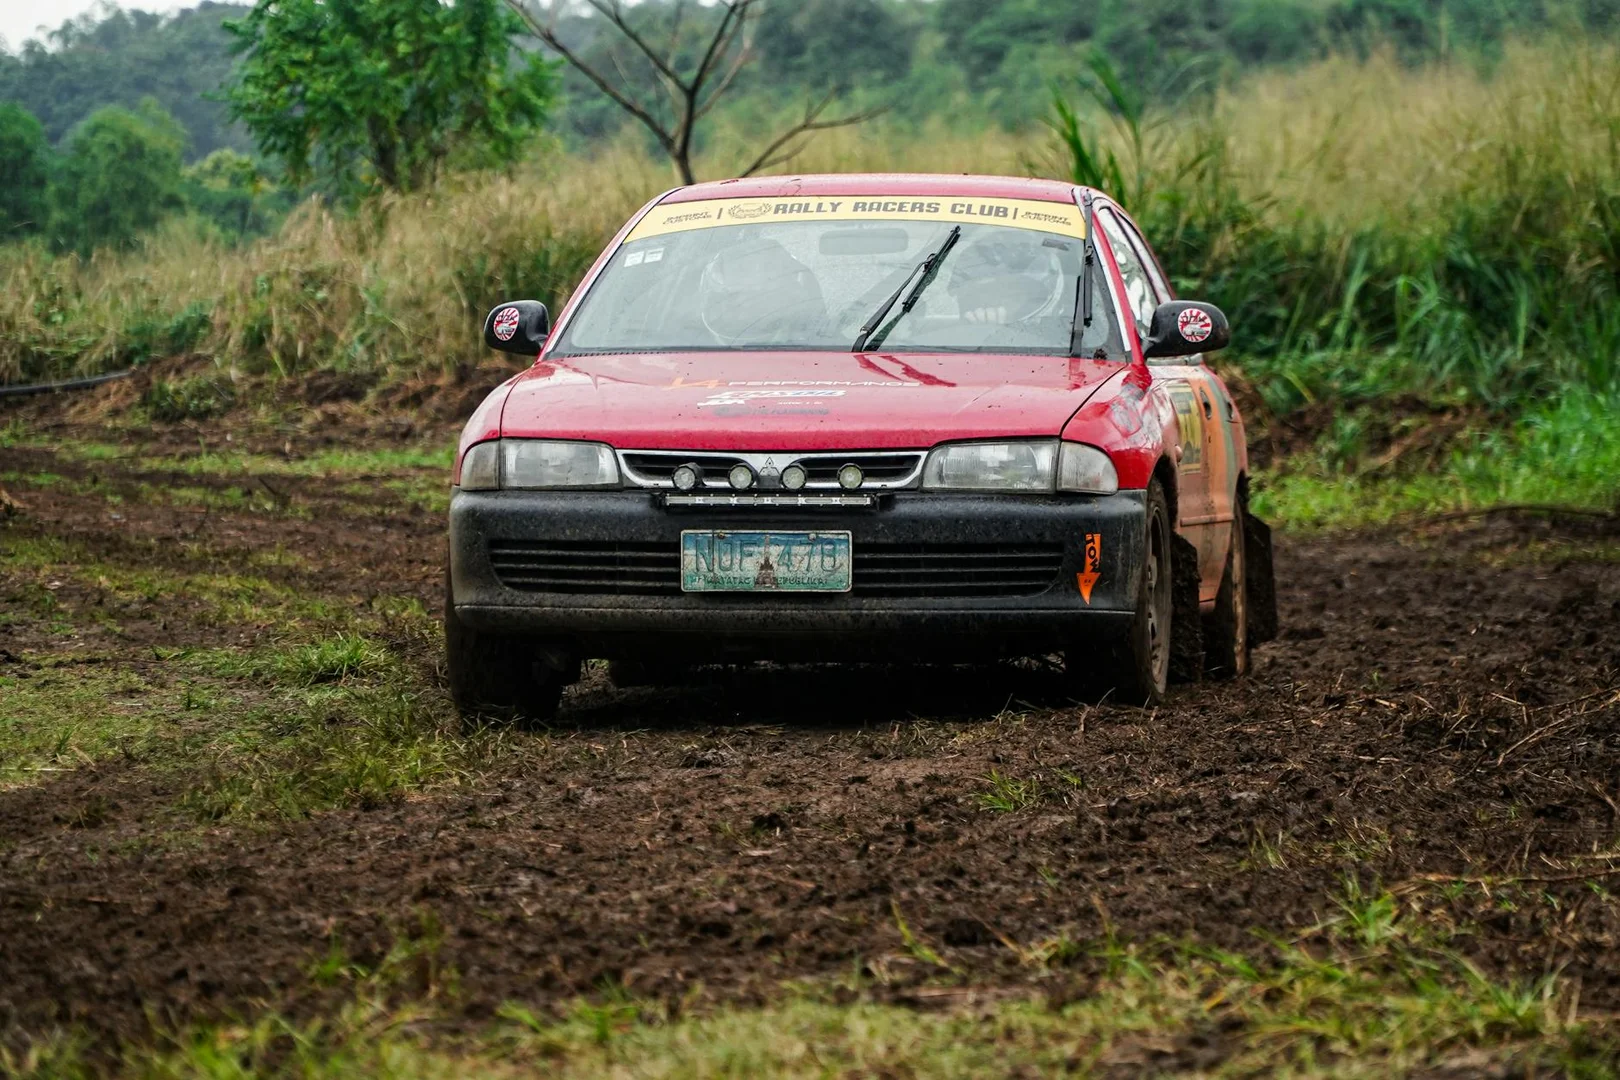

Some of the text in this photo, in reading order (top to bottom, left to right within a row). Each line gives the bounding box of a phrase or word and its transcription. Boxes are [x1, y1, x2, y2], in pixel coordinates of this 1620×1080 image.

[773, 201, 1009, 218] RALLY RACERS CLUB
[1085, 533, 1100, 573] TOW
